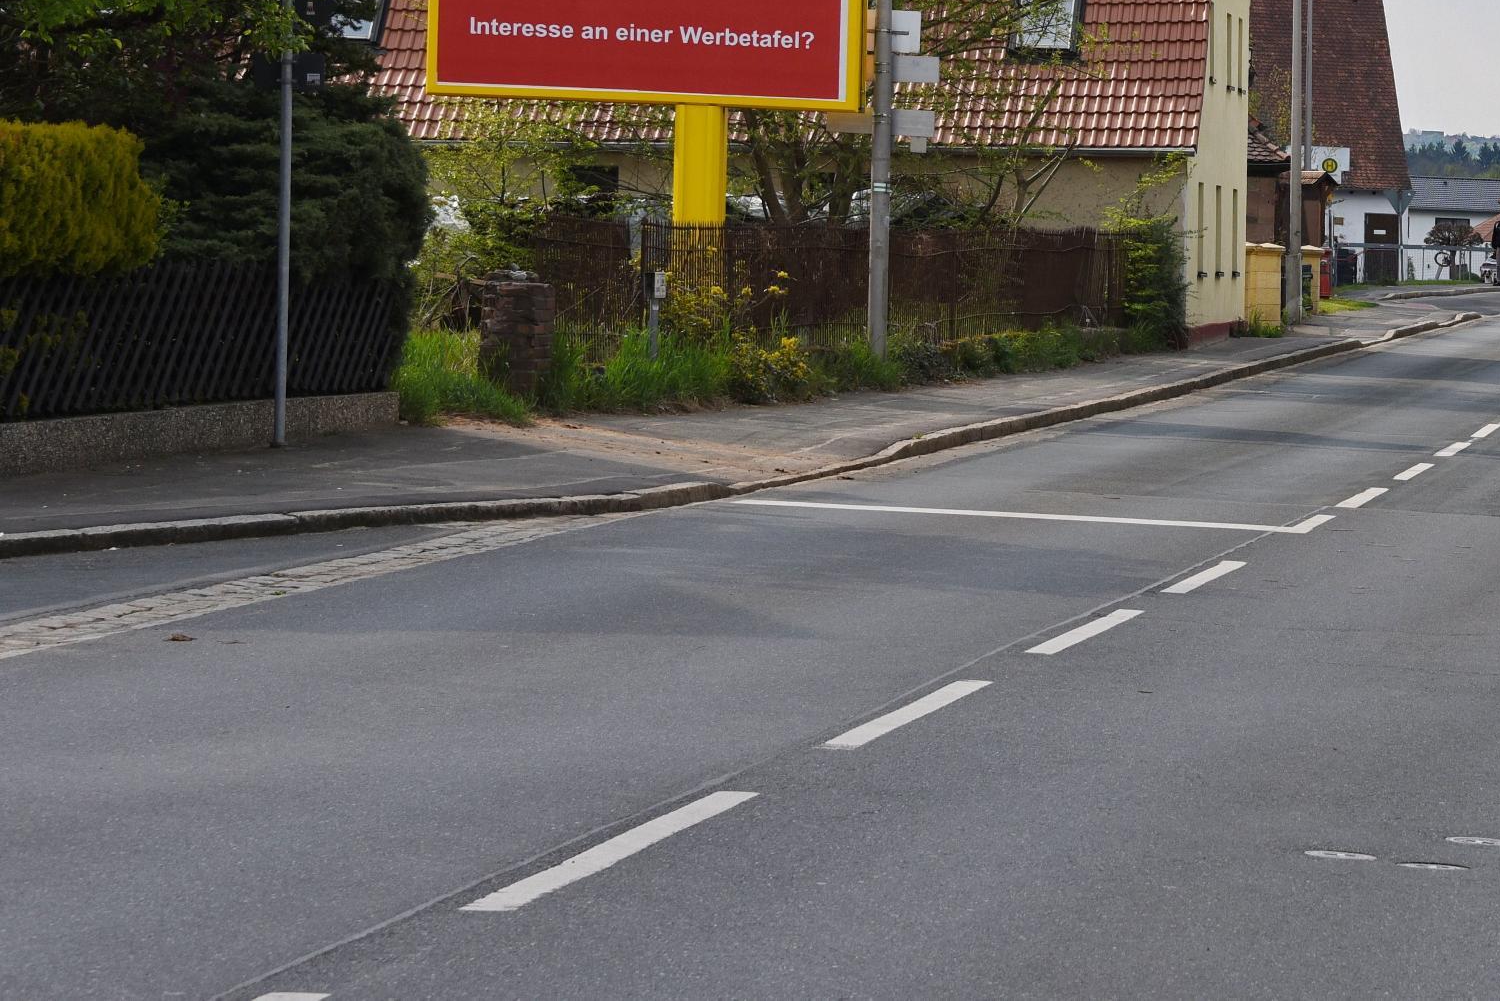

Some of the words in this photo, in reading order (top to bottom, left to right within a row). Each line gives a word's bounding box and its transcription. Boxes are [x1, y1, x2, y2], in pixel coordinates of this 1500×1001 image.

[470, 16, 574, 39] Interesse
[581, 25, 608, 40] an
[615, 23, 673, 44] einer
[679, 26, 815, 50] Werbetafel?
